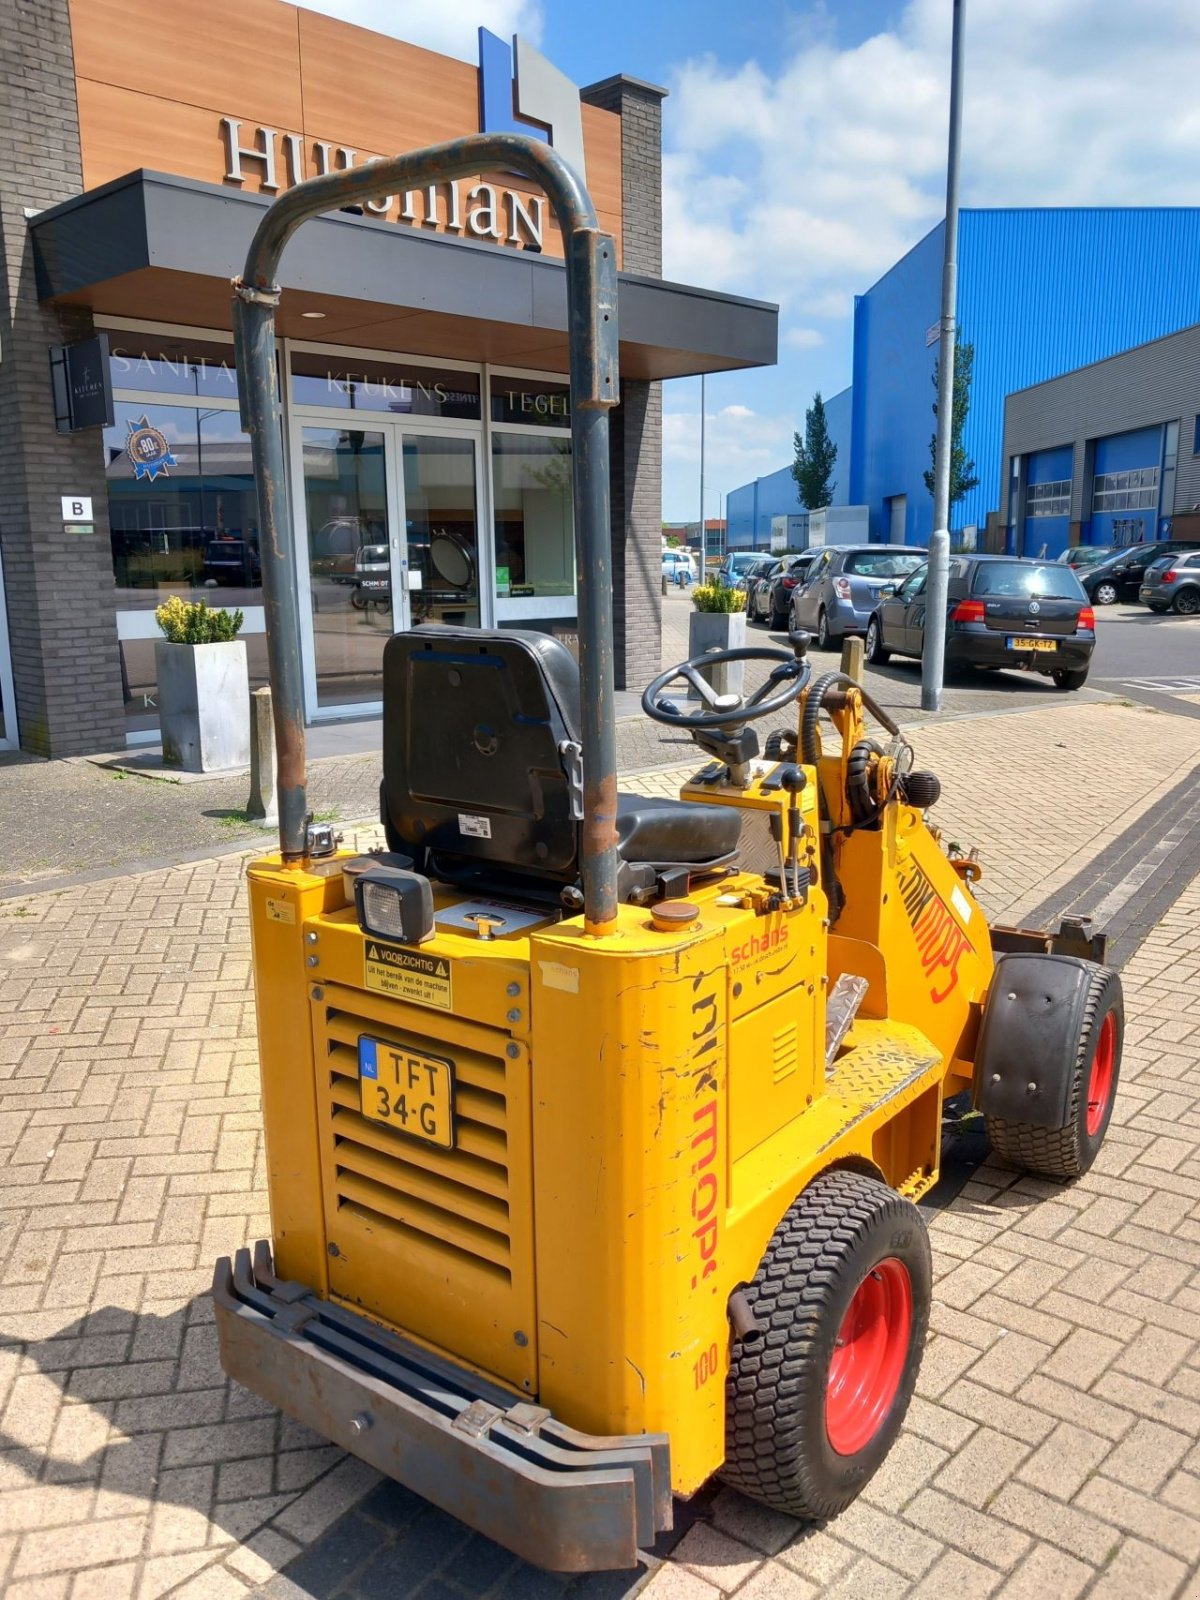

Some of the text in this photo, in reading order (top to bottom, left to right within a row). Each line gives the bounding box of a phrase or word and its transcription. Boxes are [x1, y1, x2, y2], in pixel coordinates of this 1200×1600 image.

[327, 370, 447, 404] KEUKENS
[141, 437, 155, 453] 80
[72, 502, 84, 515] B
[381, 950, 434, 971] VOORZICHTIG
[731, 924, 788, 966] schans
[365, 1062, 375, 1073] NL
[389, 1052, 438, 1096] TFT
[377, 1086, 436, 1135] 34-G
[693, 1343, 717, 1391] 100
